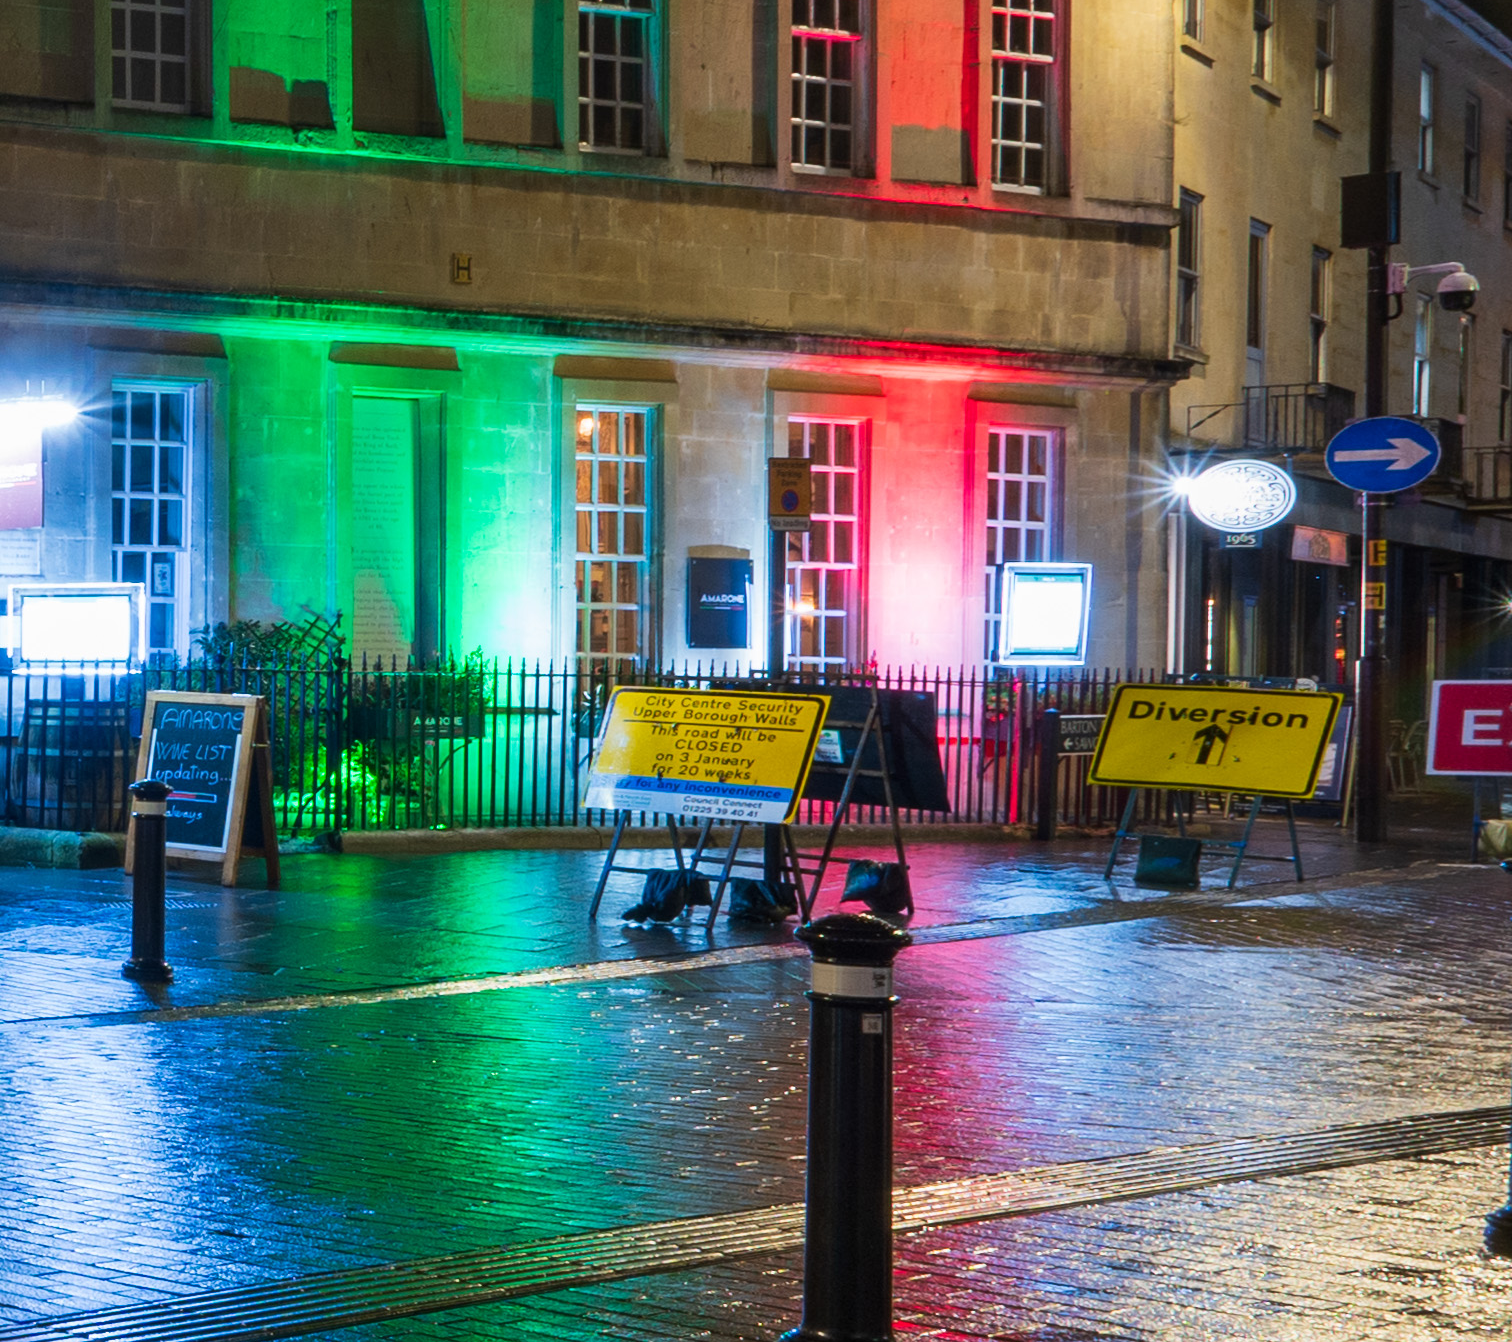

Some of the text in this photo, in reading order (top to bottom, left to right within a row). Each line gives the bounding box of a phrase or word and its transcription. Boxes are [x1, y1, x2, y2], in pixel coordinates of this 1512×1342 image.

[1226, 533, 1256, 545] 1965
[700, 593, 745, 604] AMARONE
[645, 696, 805, 715] City Centre Security
[1128, 700, 1309, 728] Diversion
[633, 707, 797, 726] Upper Borough Walls
[651, 724, 777, 743] This road will be
[1061, 720, 1097, 734] BARTON
[1461, 709, 1512, 746] E
[156, 741, 232, 761] WINE LIST
[675, 738, 743, 753] CLOSED
[655, 752, 756, 768] on 3 January
[651, 763, 751, 780] for 20 weeks
[636, 777, 653, 789] for
[657, 780, 681, 793] any
[684, 782, 782, 799] inconvenience
[684, 795, 763, 809] Council Connect
[682, 804, 759, 818] 01225 39 40 41
